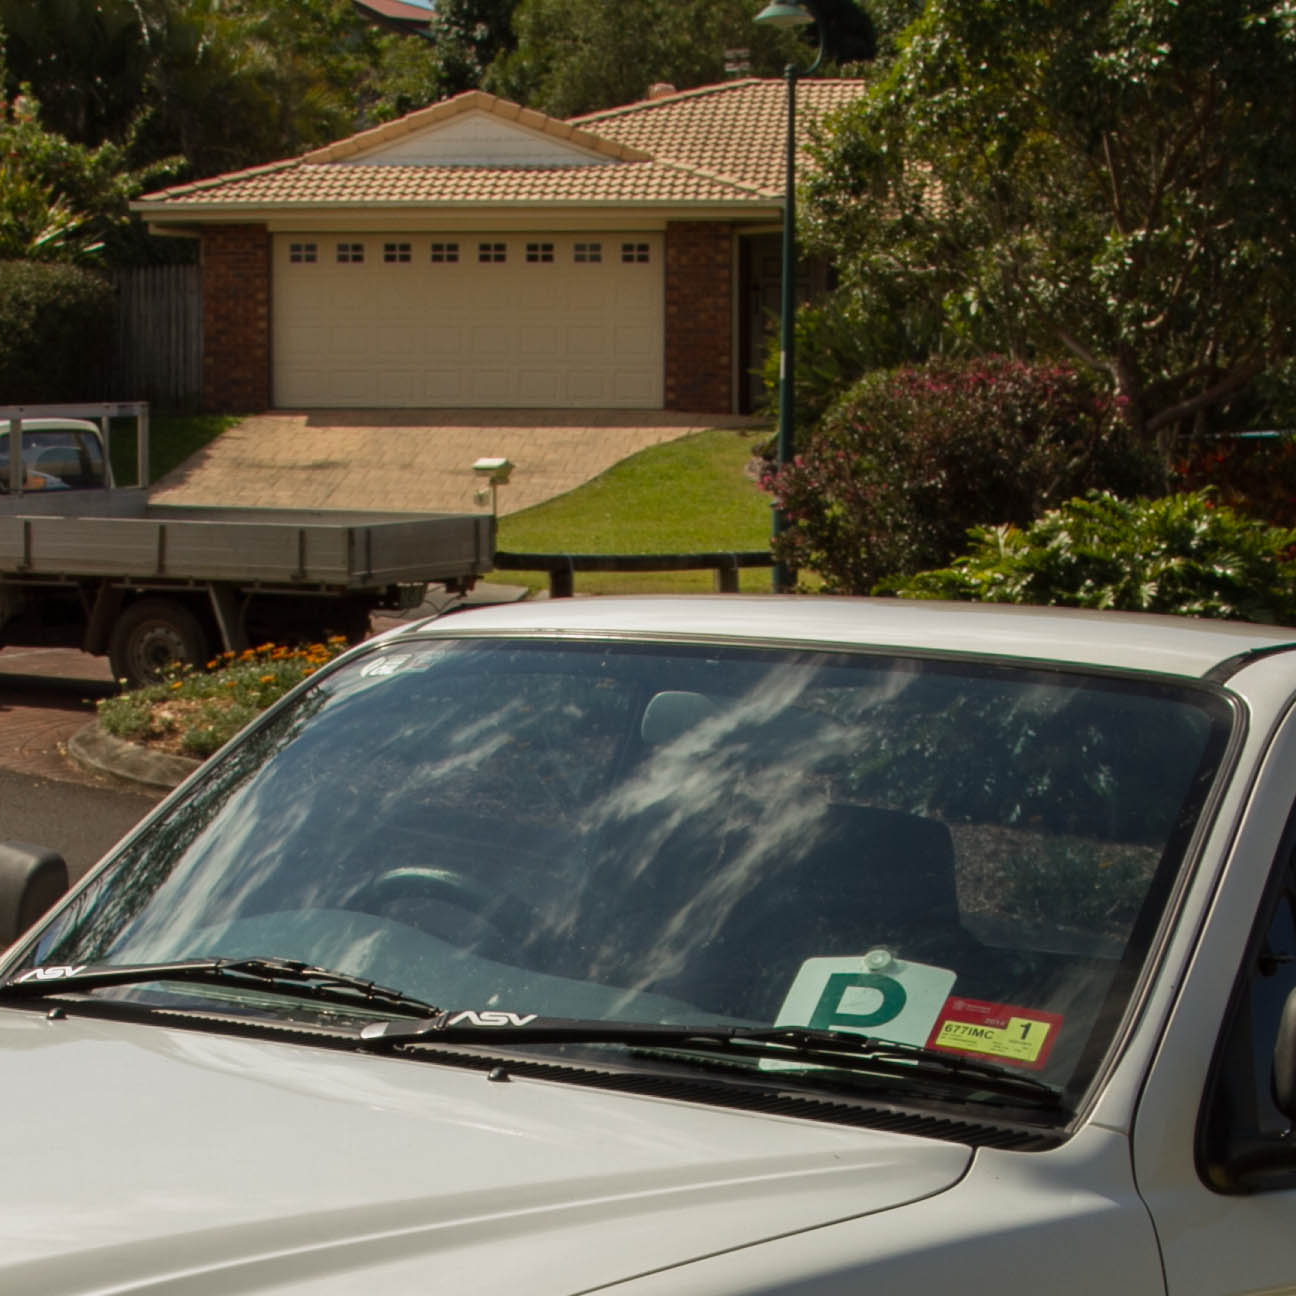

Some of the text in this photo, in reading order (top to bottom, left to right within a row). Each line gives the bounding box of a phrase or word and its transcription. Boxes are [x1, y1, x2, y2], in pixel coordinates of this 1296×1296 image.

[807, 972, 907, 1030] P
[448, 1010, 539, 1027] ASV
[944, 1023, 995, 1040] 677IMC
[1019, 1023, 1032, 1040] 1
